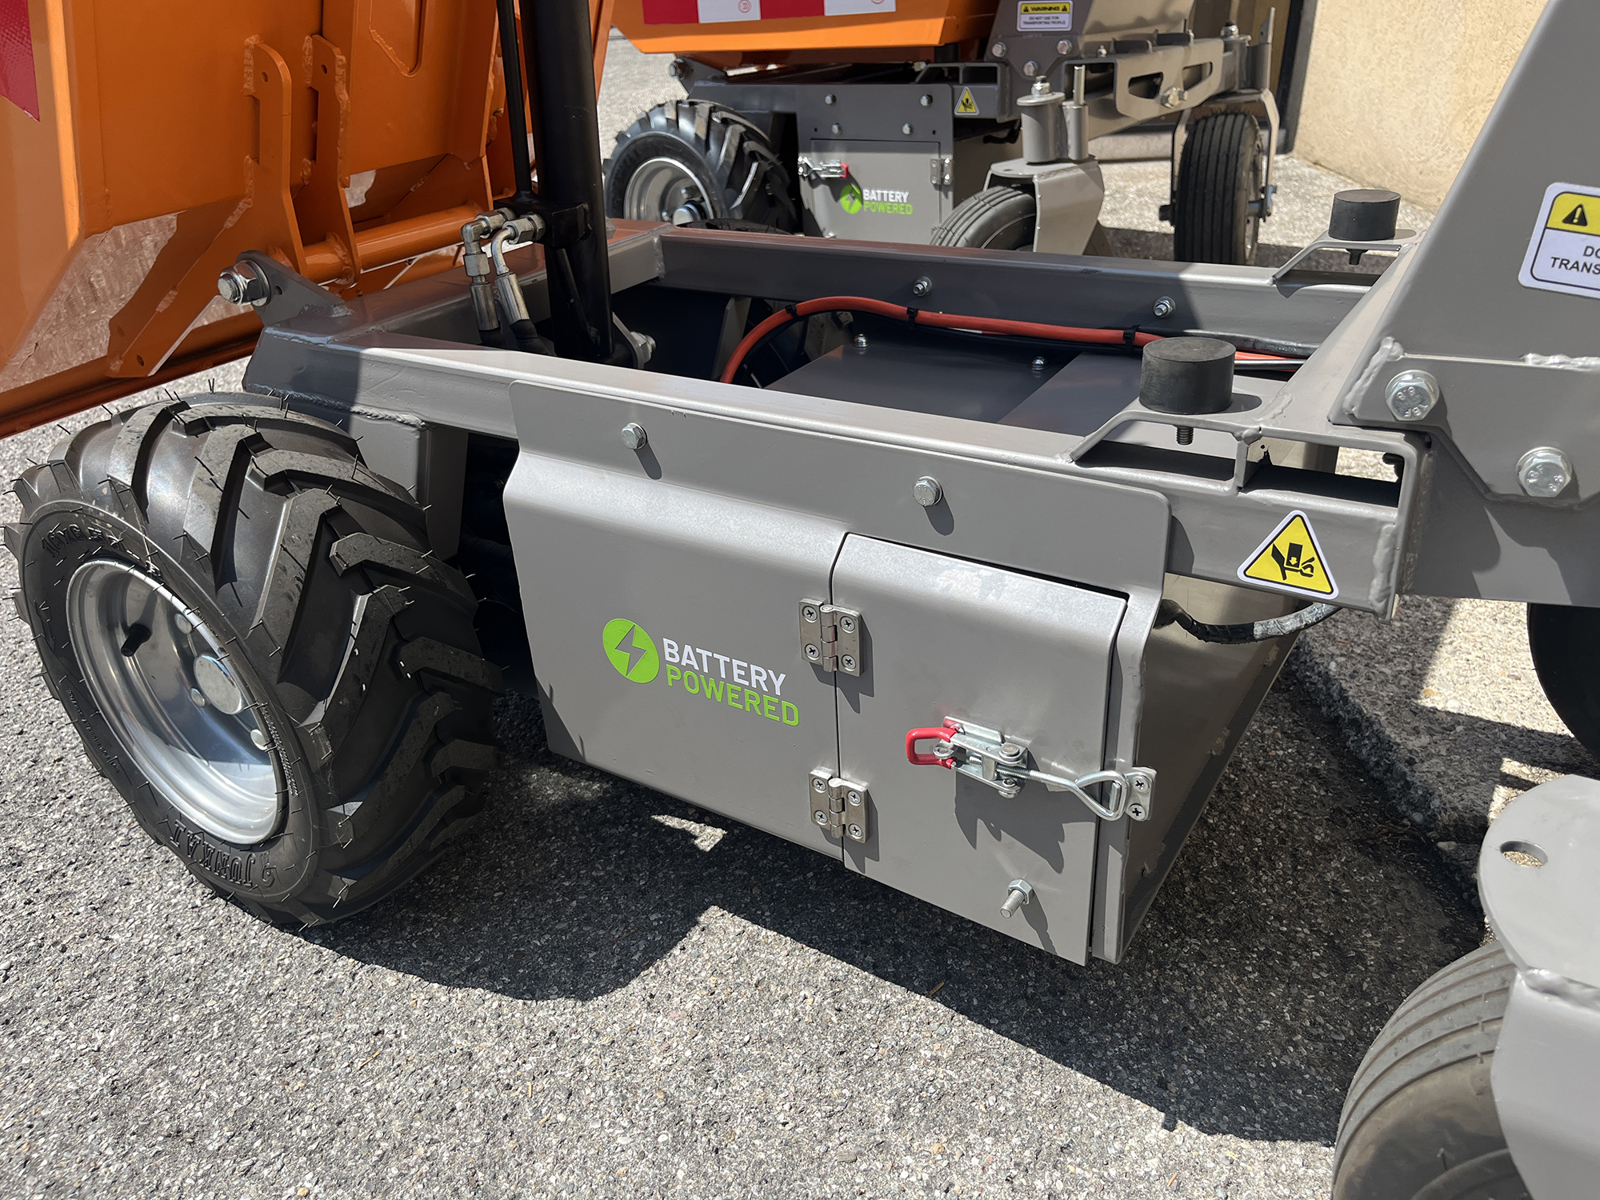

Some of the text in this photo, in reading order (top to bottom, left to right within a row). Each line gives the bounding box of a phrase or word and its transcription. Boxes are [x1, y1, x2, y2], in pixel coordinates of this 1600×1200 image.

[863, 188, 909, 203] BATTERY
[864, 201, 914, 215] POWERED
[1551, 256, 1600, 275] TRANS
[662, 637, 786, 696] BATTERY
[666, 664, 799, 727] POWERED
